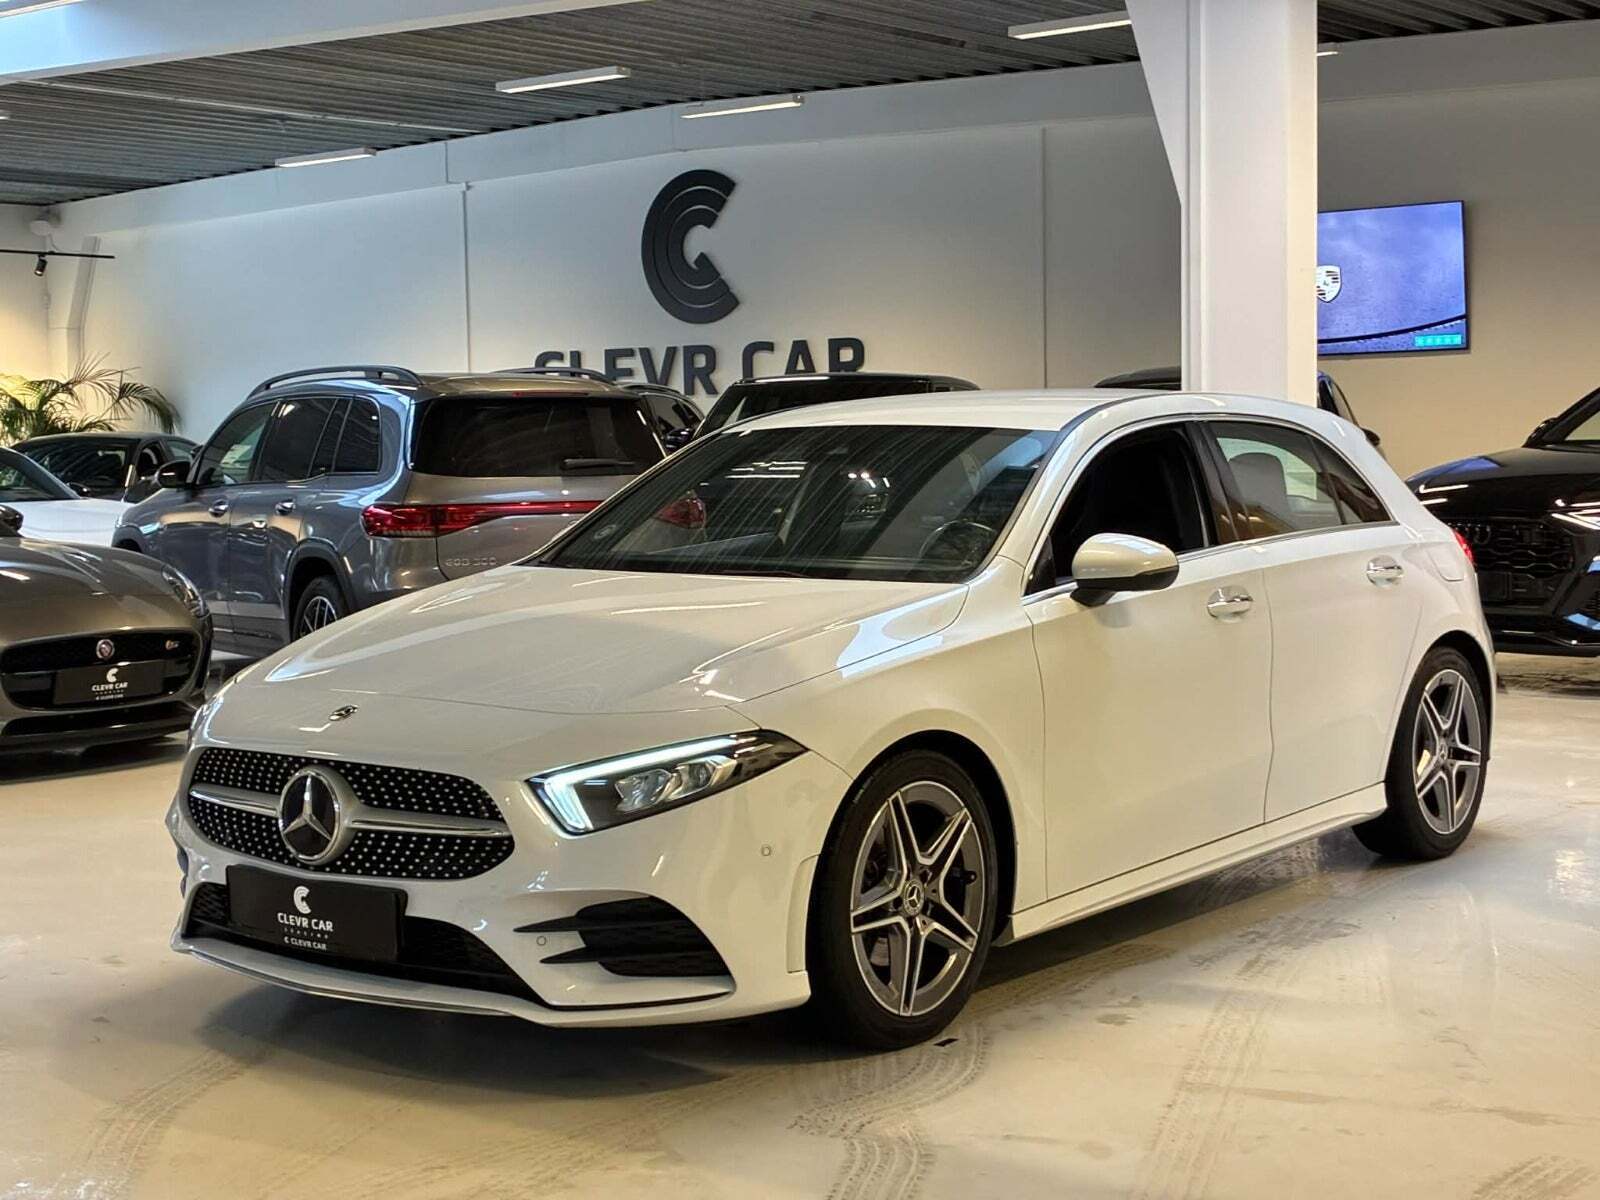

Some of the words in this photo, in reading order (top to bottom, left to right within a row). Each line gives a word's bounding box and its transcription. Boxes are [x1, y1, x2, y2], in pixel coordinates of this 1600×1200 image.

[742, 337, 865, 380] CAR
[277, 912, 309, 928] CLEVR
[311, 919, 334, 932] CAR
